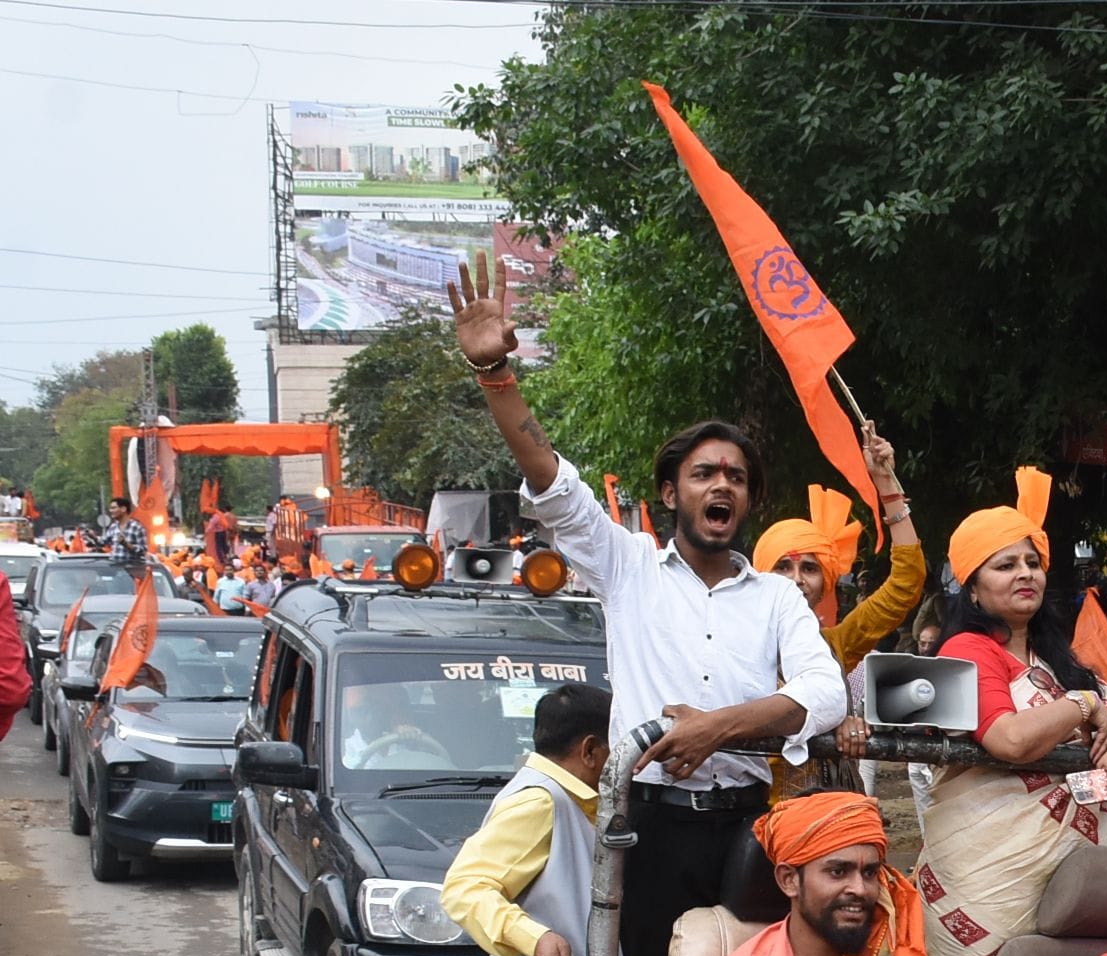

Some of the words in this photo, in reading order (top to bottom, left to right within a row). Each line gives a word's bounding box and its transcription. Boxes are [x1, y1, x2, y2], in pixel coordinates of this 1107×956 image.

[391, 118, 412, 126] TIME
[440, 662, 485, 681] जय
[538, 663, 587, 683] बाबा
